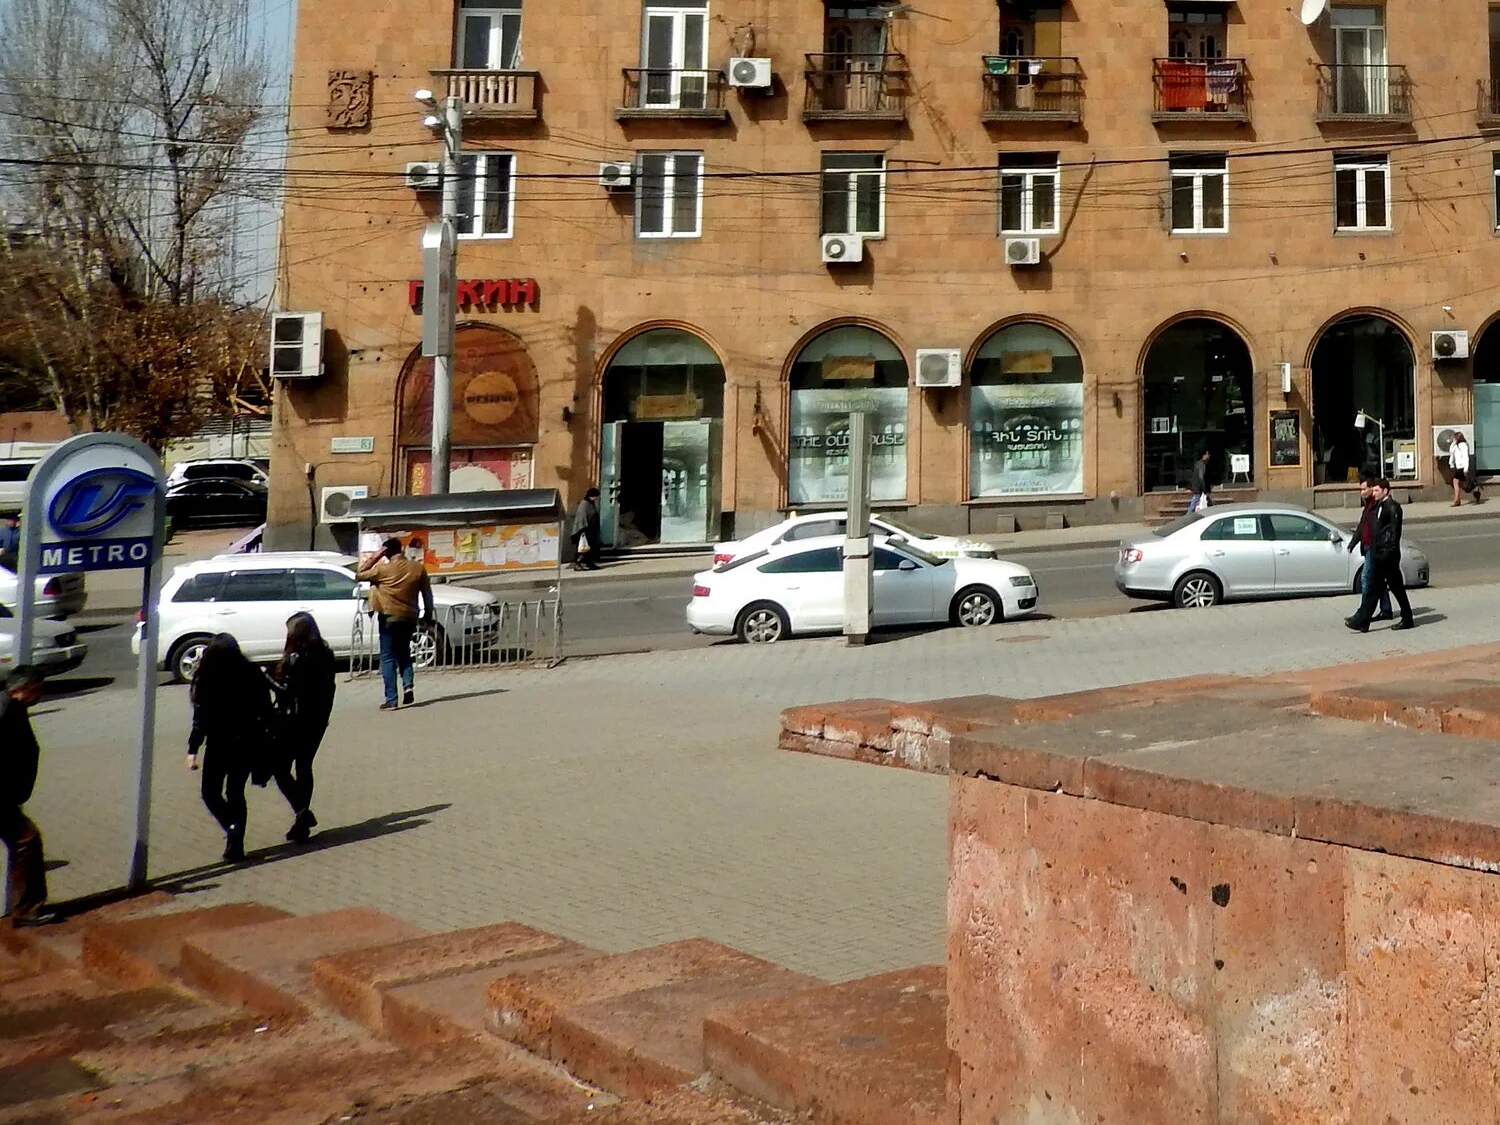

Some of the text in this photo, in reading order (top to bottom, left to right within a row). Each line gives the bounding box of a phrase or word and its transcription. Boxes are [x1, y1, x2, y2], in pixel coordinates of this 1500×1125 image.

[409, 278, 535, 305] ПКИН
[797, 436, 822, 447] THE
[42, 542, 148, 567] METRO
